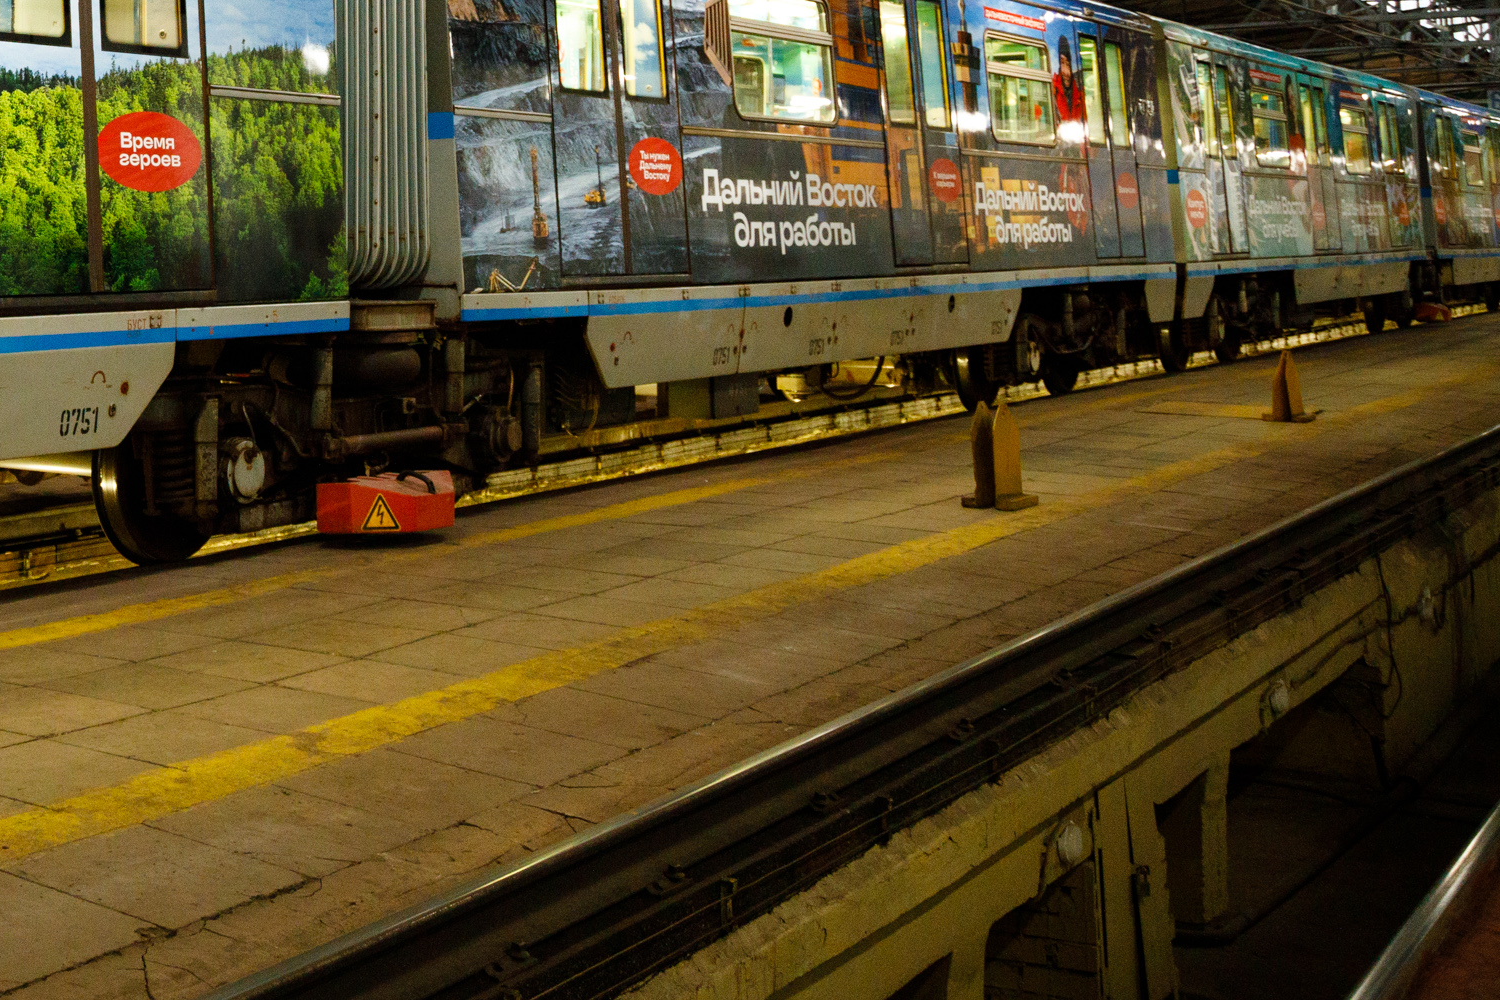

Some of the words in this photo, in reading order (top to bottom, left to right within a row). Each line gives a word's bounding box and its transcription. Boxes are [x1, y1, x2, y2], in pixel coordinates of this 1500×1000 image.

[119, 131, 176, 153] Время
[119, 152, 182, 171] героев
[701, 167, 804, 212] Дальний
[805, 173, 878, 208] Восток
[974, 181, 1037, 216] Дальний
[1038, 184, 1086, 213] Восток
[733, 211, 777, 248] для
[779, 212, 857, 256] работы
[995, 214, 1022, 244] для
[1022, 216, 1073, 250] работы
[59, 406, 99, 437] 0751
